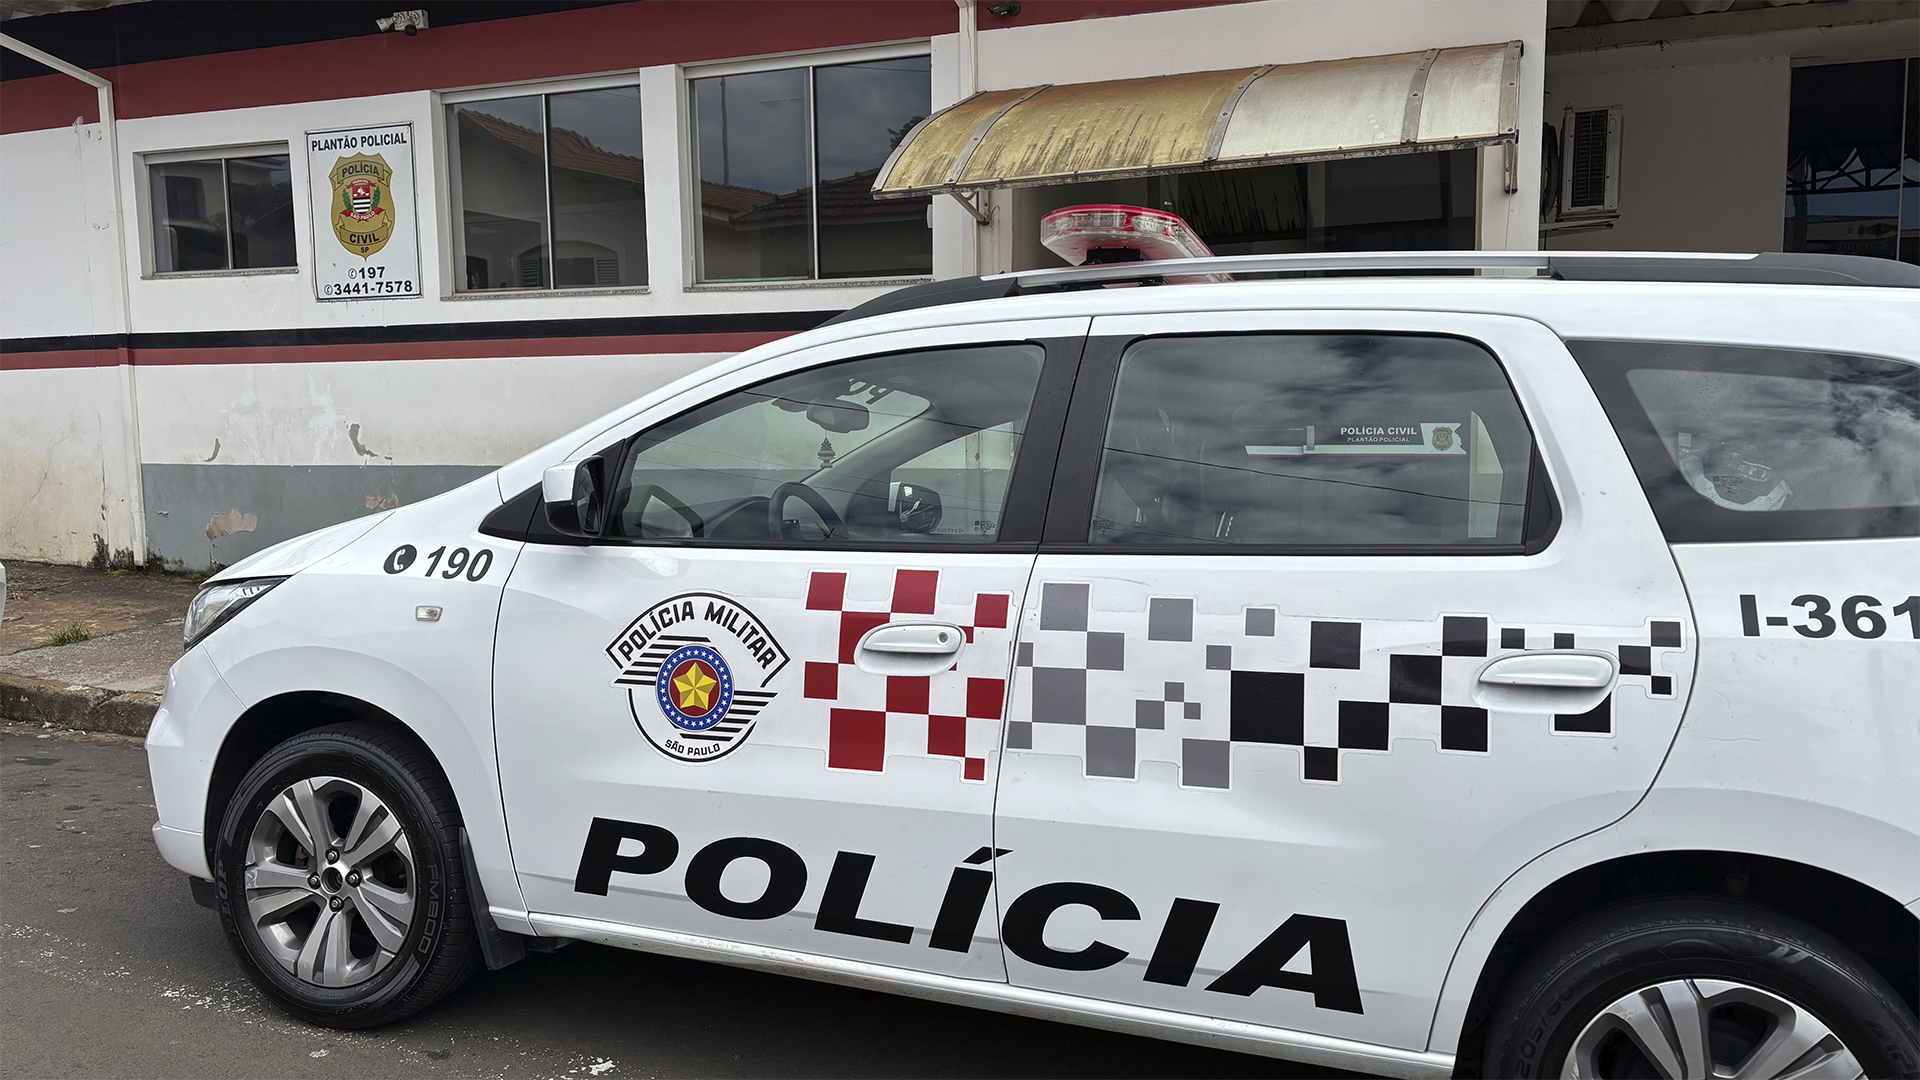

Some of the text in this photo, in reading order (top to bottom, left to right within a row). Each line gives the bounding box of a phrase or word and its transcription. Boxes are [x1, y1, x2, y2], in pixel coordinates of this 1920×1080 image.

[312, 132, 408, 152] PLANTÃO POLICIAL
[342, 161, 380, 178] POLÍCIA
[349, 232, 380, 244] CIVIL
[360, 246, 370, 254] SP
[358, 266, 386, 280] 197
[333, 280, 413, 296] 3441-7578
[1340, 425, 1418, 436] POLÍCIA CIVIL
[1347, 435, 1378, 443] PLANTÃO
[424, 545, 494, 582] 190
[617, 600, 778, 670] POLÍCIA MILITAR
[664, 738, 721, 756] SÃO PAULO
[419, 864, 441, 954] FM800
[574, 816, 1365, 1015] POLÍCIA
